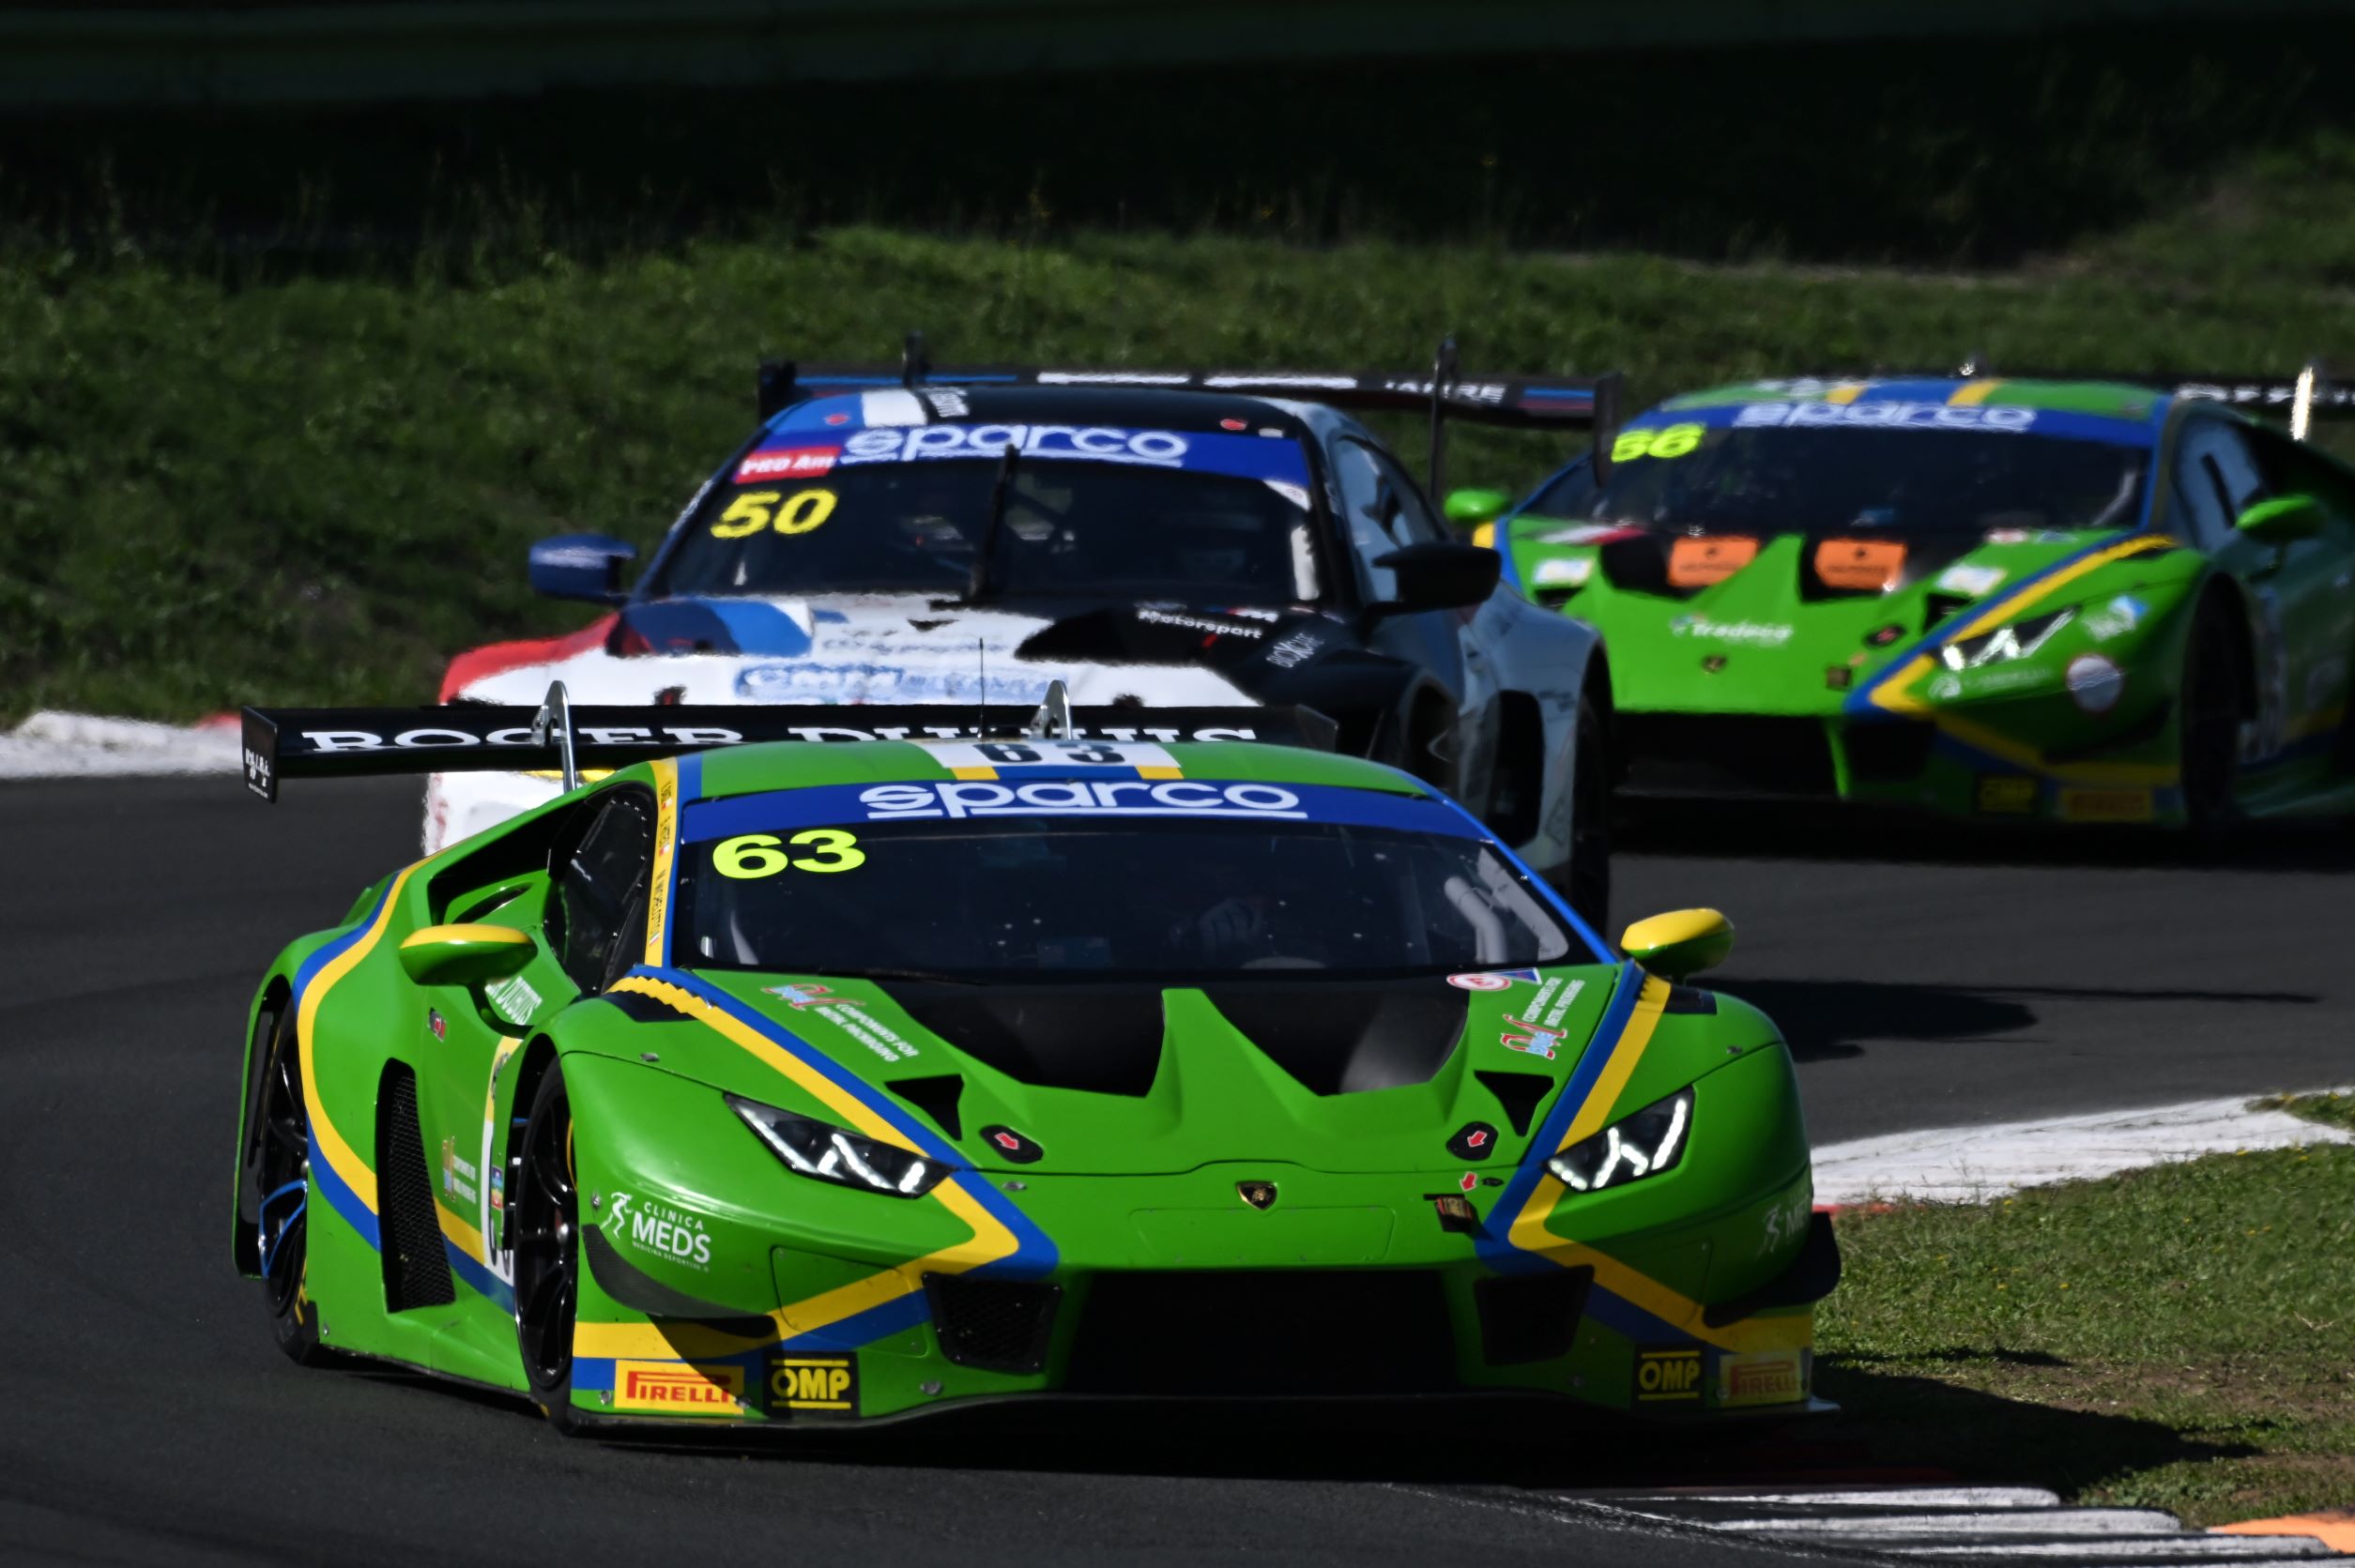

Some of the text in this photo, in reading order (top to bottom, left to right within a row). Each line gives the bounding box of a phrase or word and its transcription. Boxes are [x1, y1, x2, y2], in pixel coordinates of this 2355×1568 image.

[840, 424, 1186, 467] sparco
[711, 489, 838, 539] 50
[301, 726, 1256, 752] ROGER DUUIS
[972, 743, 1125, 763] 63
[858, 781, 1308, 819] sparco
[712, 830, 865, 879] 63
[643, 1201, 704, 1230] CLINICA
[632, 1210, 711, 1264] MEDS
[626, 1370, 732, 1405] PIRELLI
[771, 1366, 851, 1400] OMP
[1638, 1358, 1701, 1392] OMP
